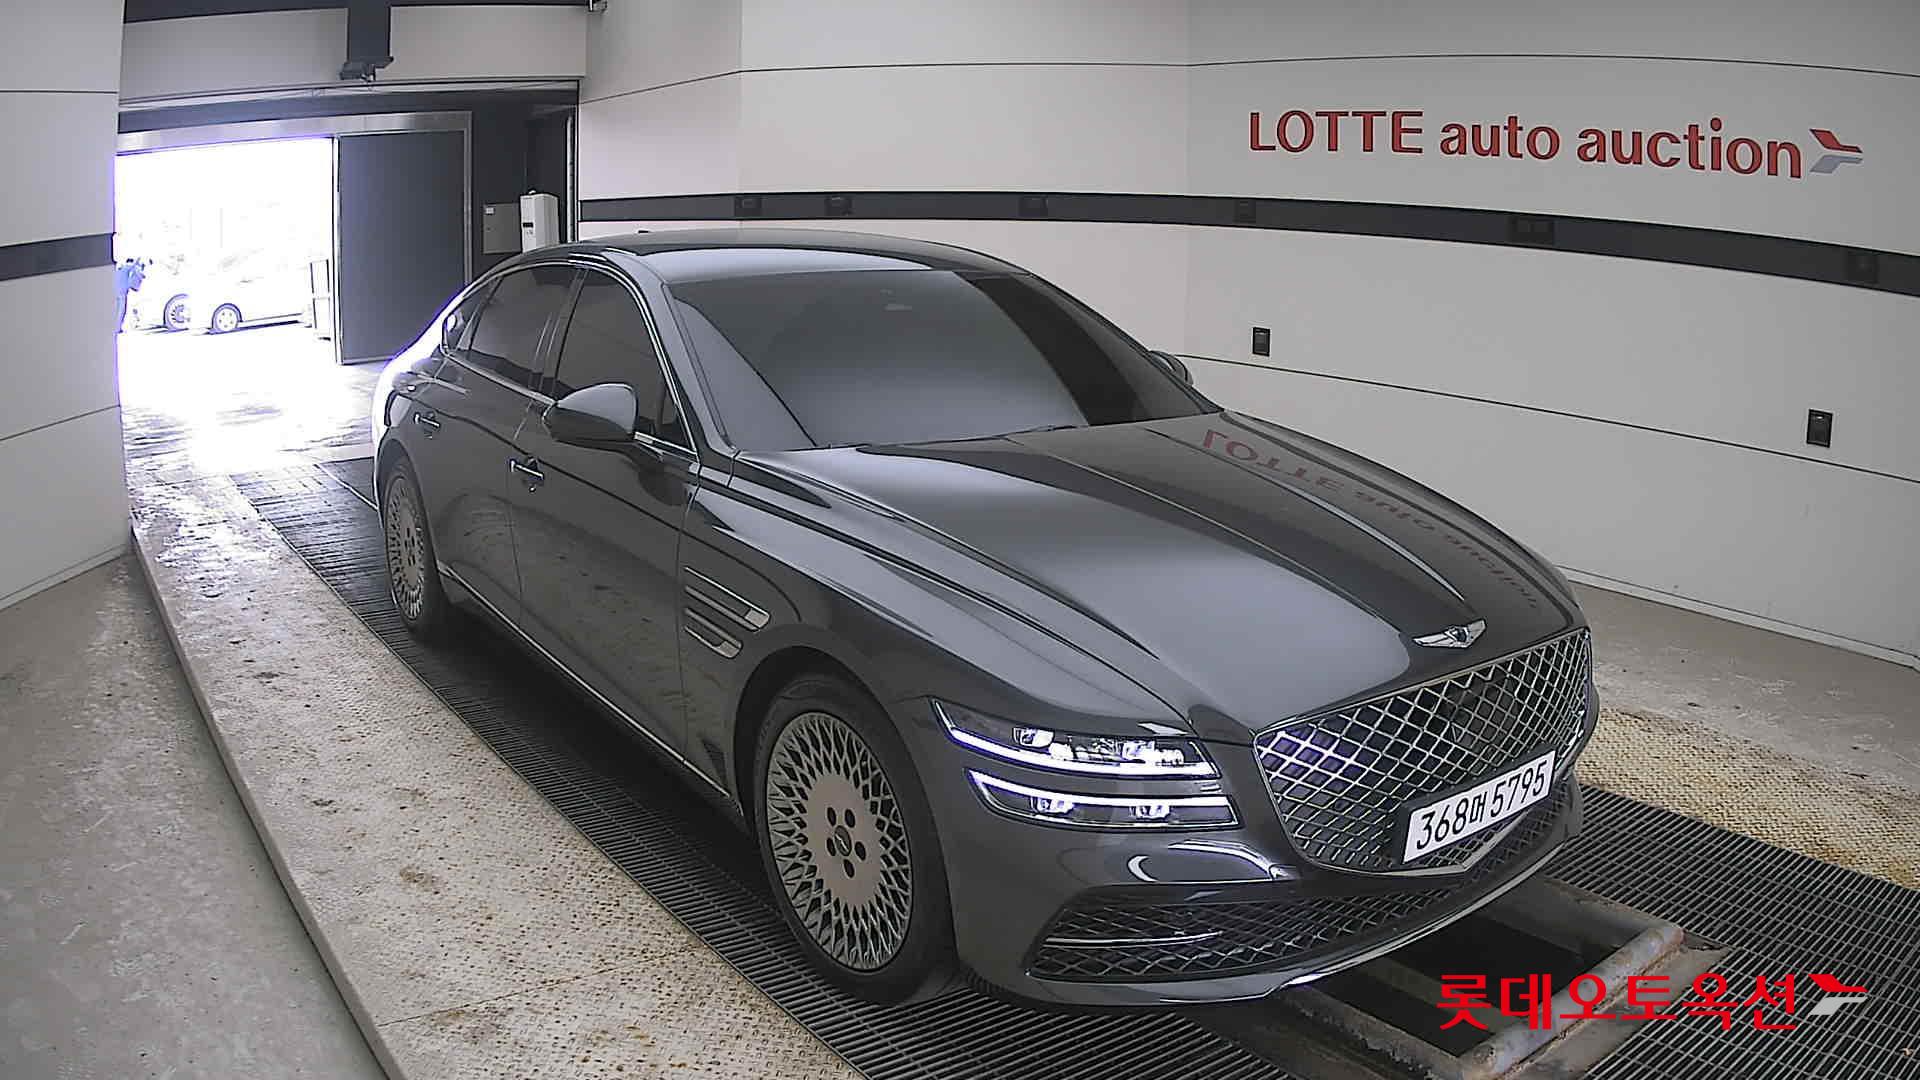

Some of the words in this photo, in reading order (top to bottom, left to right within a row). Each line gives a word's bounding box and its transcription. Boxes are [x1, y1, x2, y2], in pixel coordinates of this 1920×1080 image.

[1249, 111, 1424, 154] LOTTE
[1440, 115, 1560, 160] auto
[1577, 117, 1802, 178] auction
[1416, 791, 1488, 850] 368머
[1490, 759, 1548, 818] 5795
